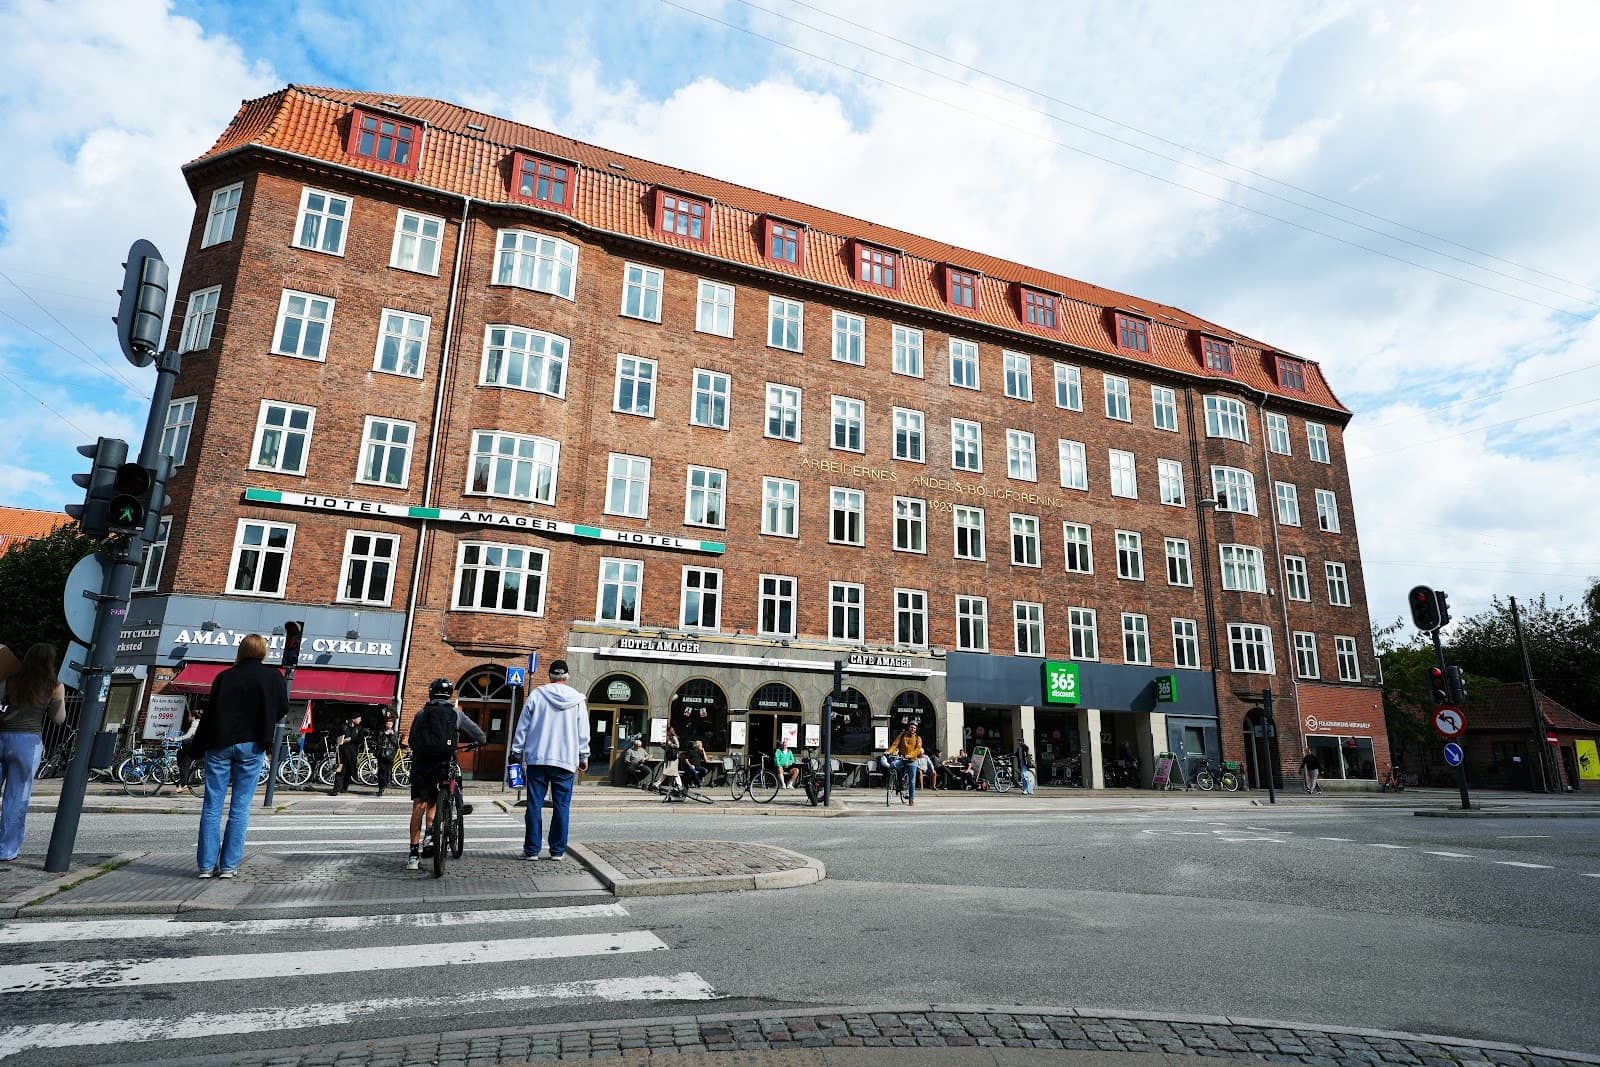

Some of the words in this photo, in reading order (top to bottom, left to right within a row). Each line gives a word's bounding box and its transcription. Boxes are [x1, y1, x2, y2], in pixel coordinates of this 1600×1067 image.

[929, 500, 952, 513] 1923
[304, 496, 388, 514] HOTEL
[459, 512, 559, 530] AMAGER
[617, 532, 684, 547] HOTEL
[120, 630, 133, 639] ITY
[133, 629, 160, 638] CYKLER
[117, 641, 143, 651] rksted
[312, 638, 393, 656] CYKLER
[620, 639, 654, 650] HOTEL
[656, 640, 700, 653] AMAGER
[876, 656, 912, 668] AMAGER
[1050, 672, 1075, 690] 365
[1158, 682, 1171, 694] 365
